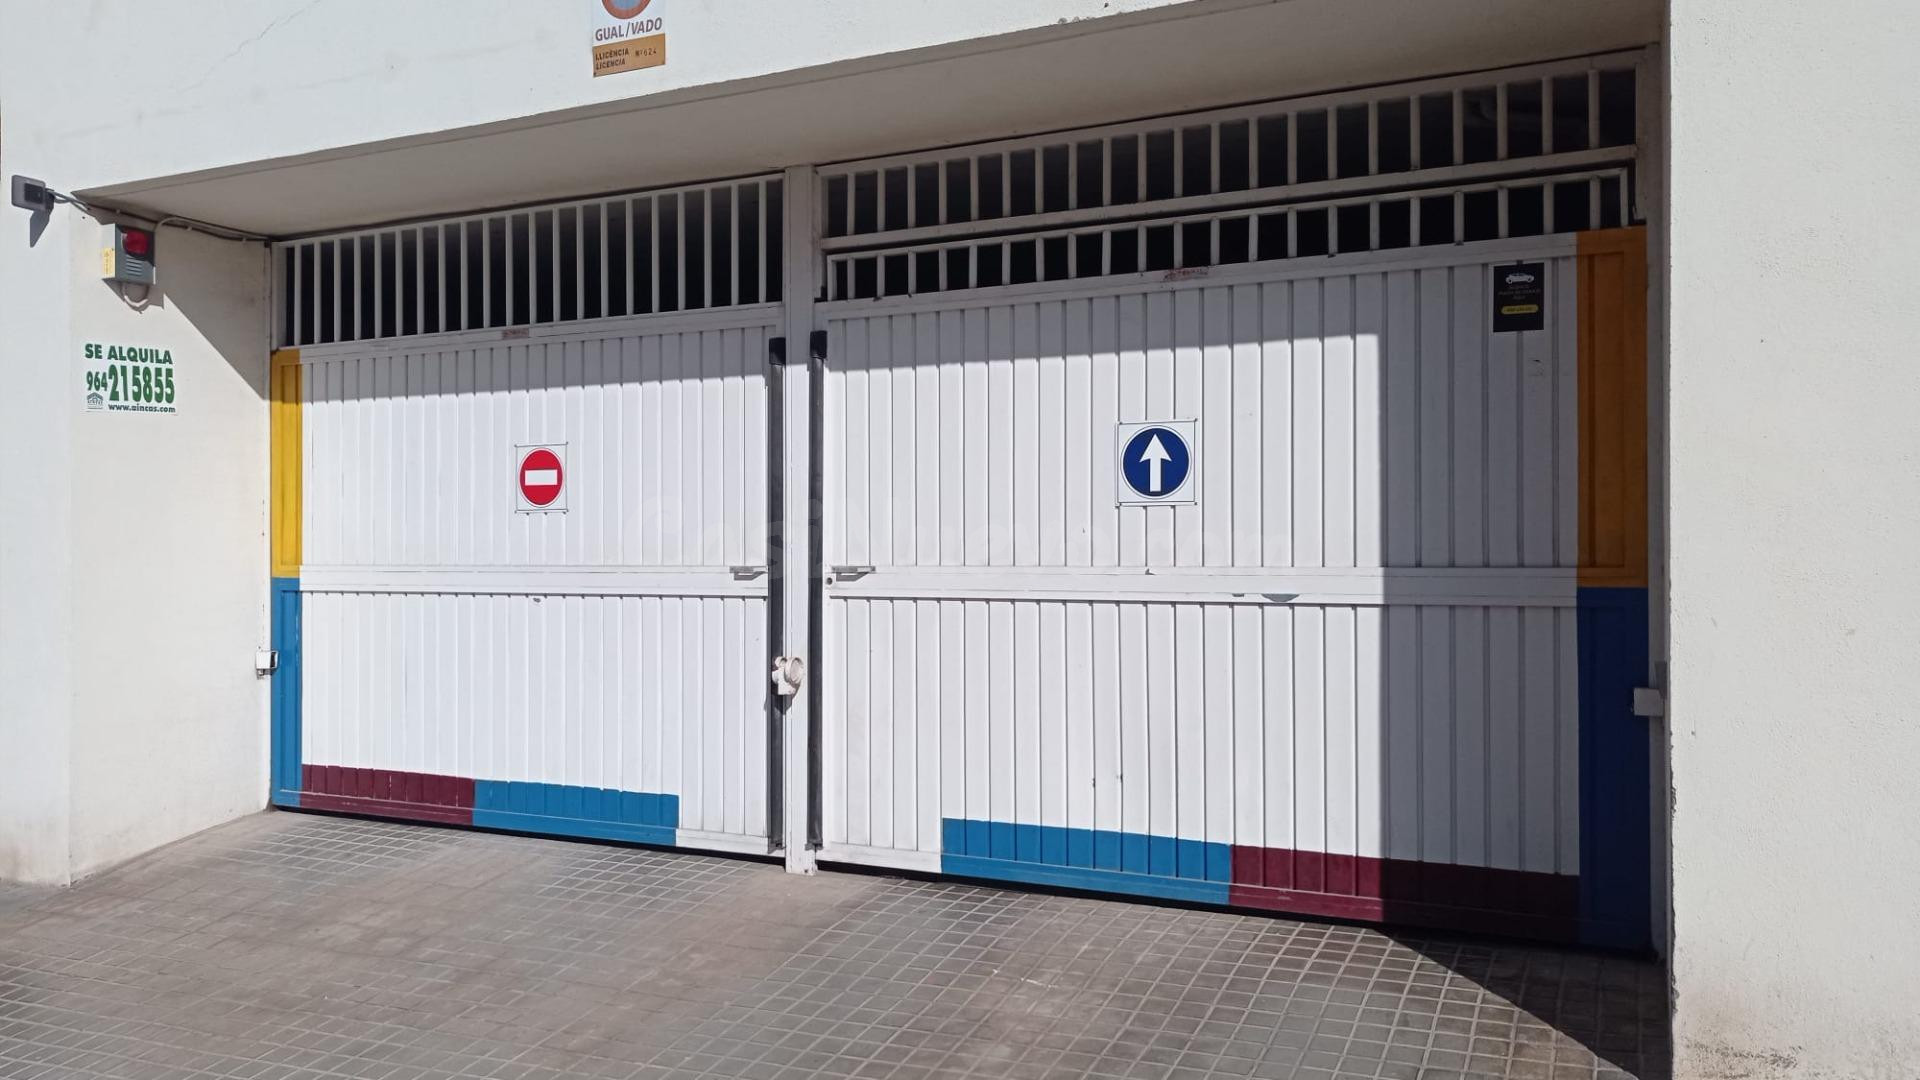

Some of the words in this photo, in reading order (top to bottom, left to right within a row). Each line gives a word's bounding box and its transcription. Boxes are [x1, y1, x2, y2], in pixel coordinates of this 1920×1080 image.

[595, 17, 663, 42] GUAL/VADO
[596, 58, 626, 70] LICENCIA
[85, 343, 103, 359] SE
[107, 345, 173, 365] ALQUILA
[108, 403, 176, 413] www.aincas.com
